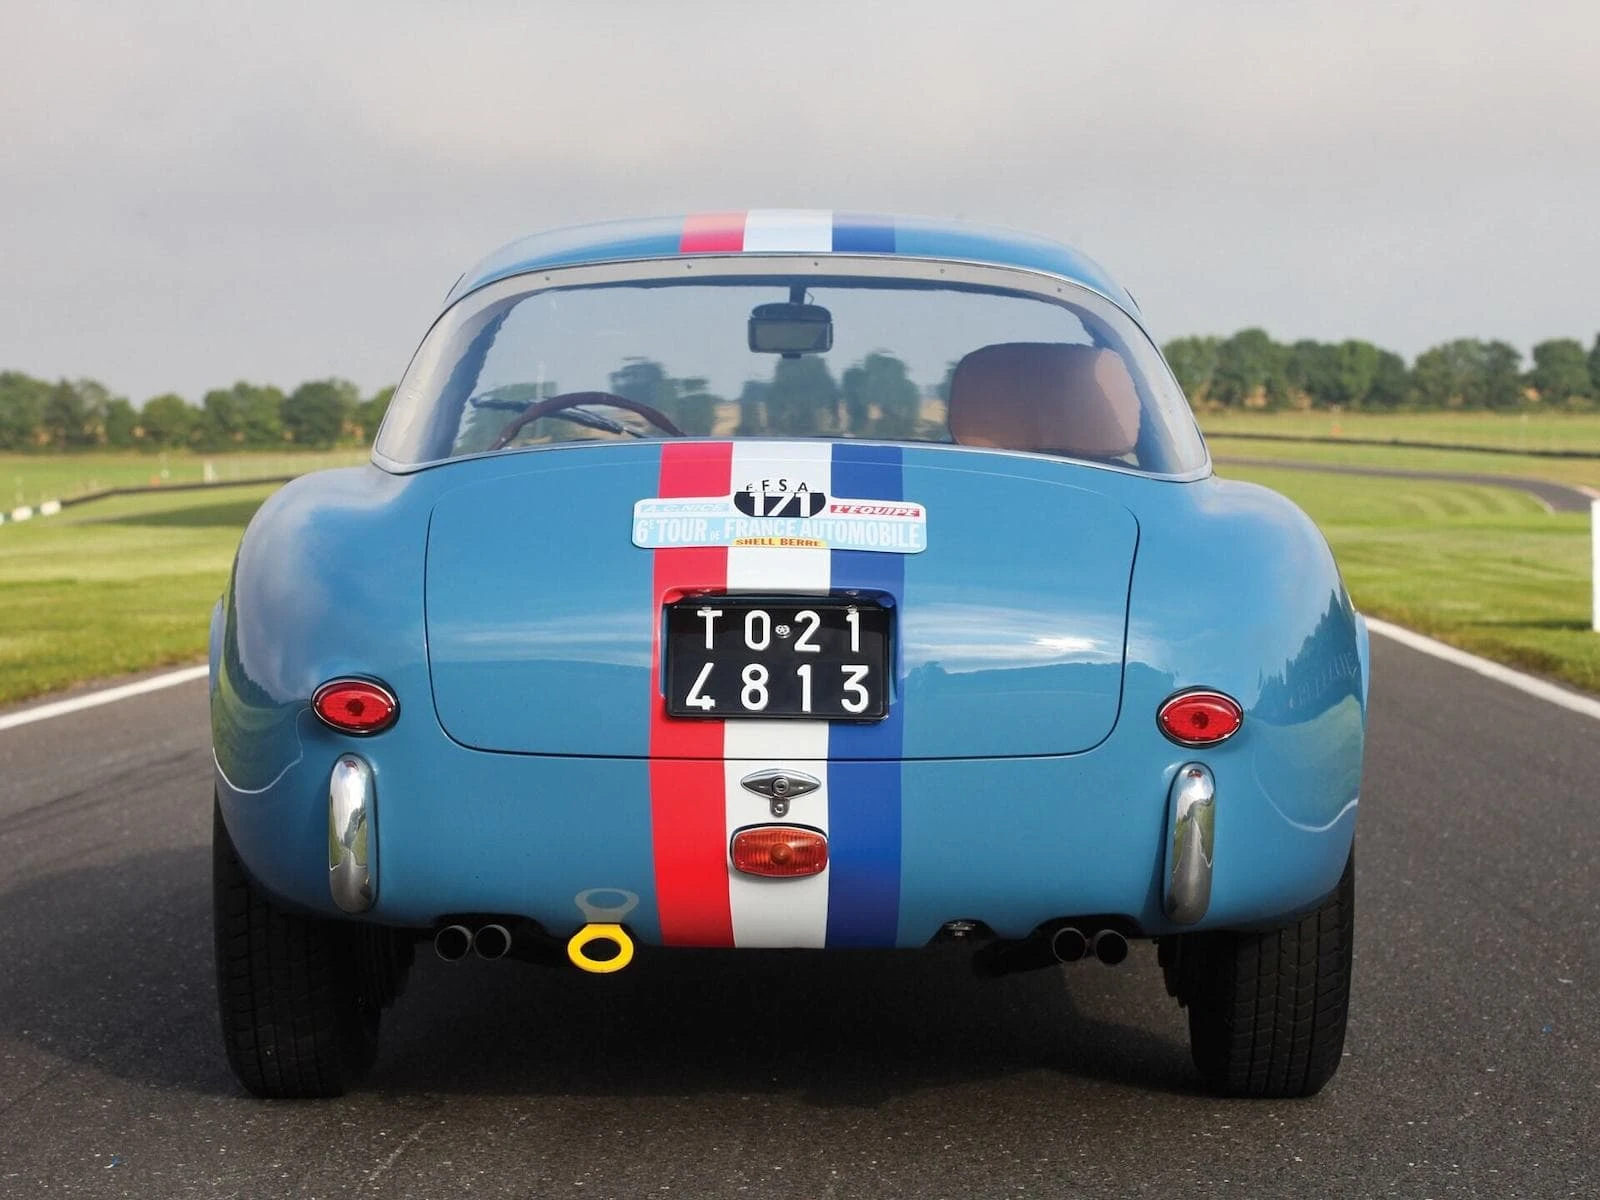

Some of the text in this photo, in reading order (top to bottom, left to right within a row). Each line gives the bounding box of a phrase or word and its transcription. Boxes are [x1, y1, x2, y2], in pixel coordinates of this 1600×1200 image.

[750, 491, 811, 518] 171
[657, 518, 708, 543] TOUR
[724, 517, 796, 539] FRANCE
[798, 517, 921, 548] AUTOMOBILE
[736, 538, 775, 546] SHELL
[685, 662, 870, 713] 4813
